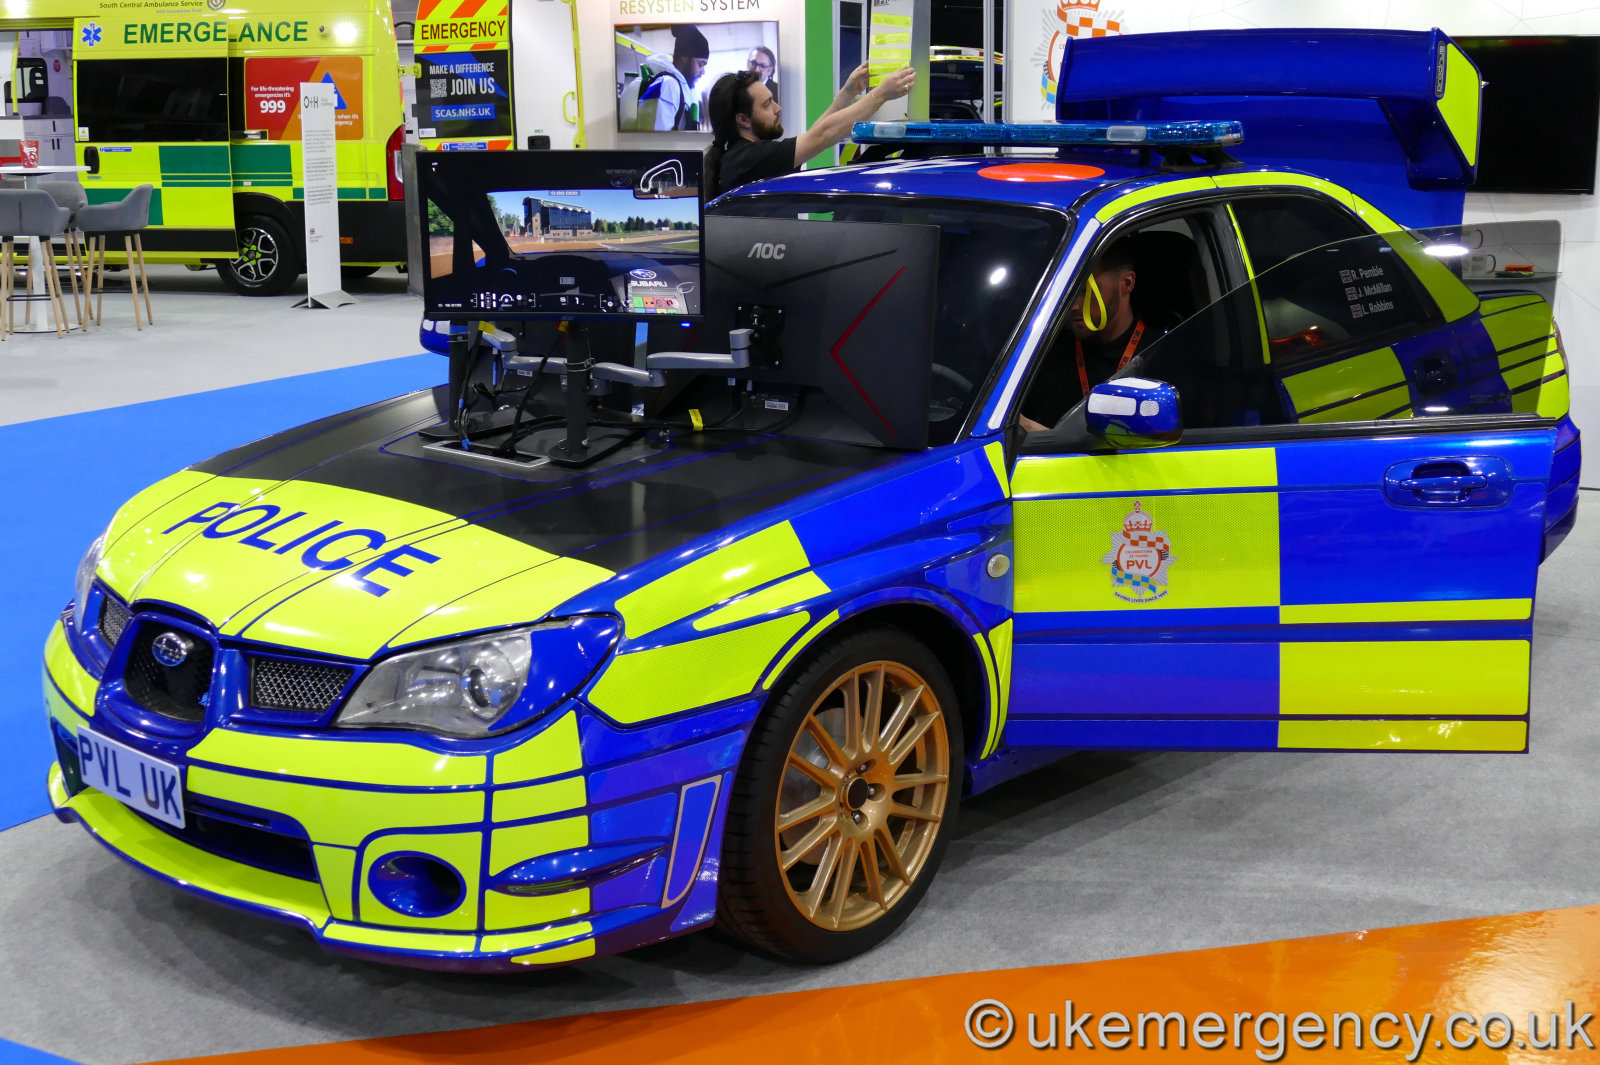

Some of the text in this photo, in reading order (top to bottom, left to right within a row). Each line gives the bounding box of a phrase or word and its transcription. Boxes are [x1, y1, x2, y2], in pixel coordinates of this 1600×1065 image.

[99, 1, 118, 9] South
[144, 0, 179, 8] Ambulance
[700, 0, 760, 12] SYSTEM
[421, 20, 506, 40] EMERGENCY
[429, 62, 495, 75] MAKE A DIFFERENCE
[450, 77, 496, 96] JOIN US
[259, 100, 286, 114] 999
[435, 107, 491, 118] SCAS.NHS.UK
[748, 243, 786, 260] AOC
[1359, 265, 1384, 279] Pemble
[1368, 299, 1394, 314] Robbins
[161, 501, 442, 598] POLICE
[1126, 559, 1152, 570] PVL
[79, 741, 182, 820] PVL UK
